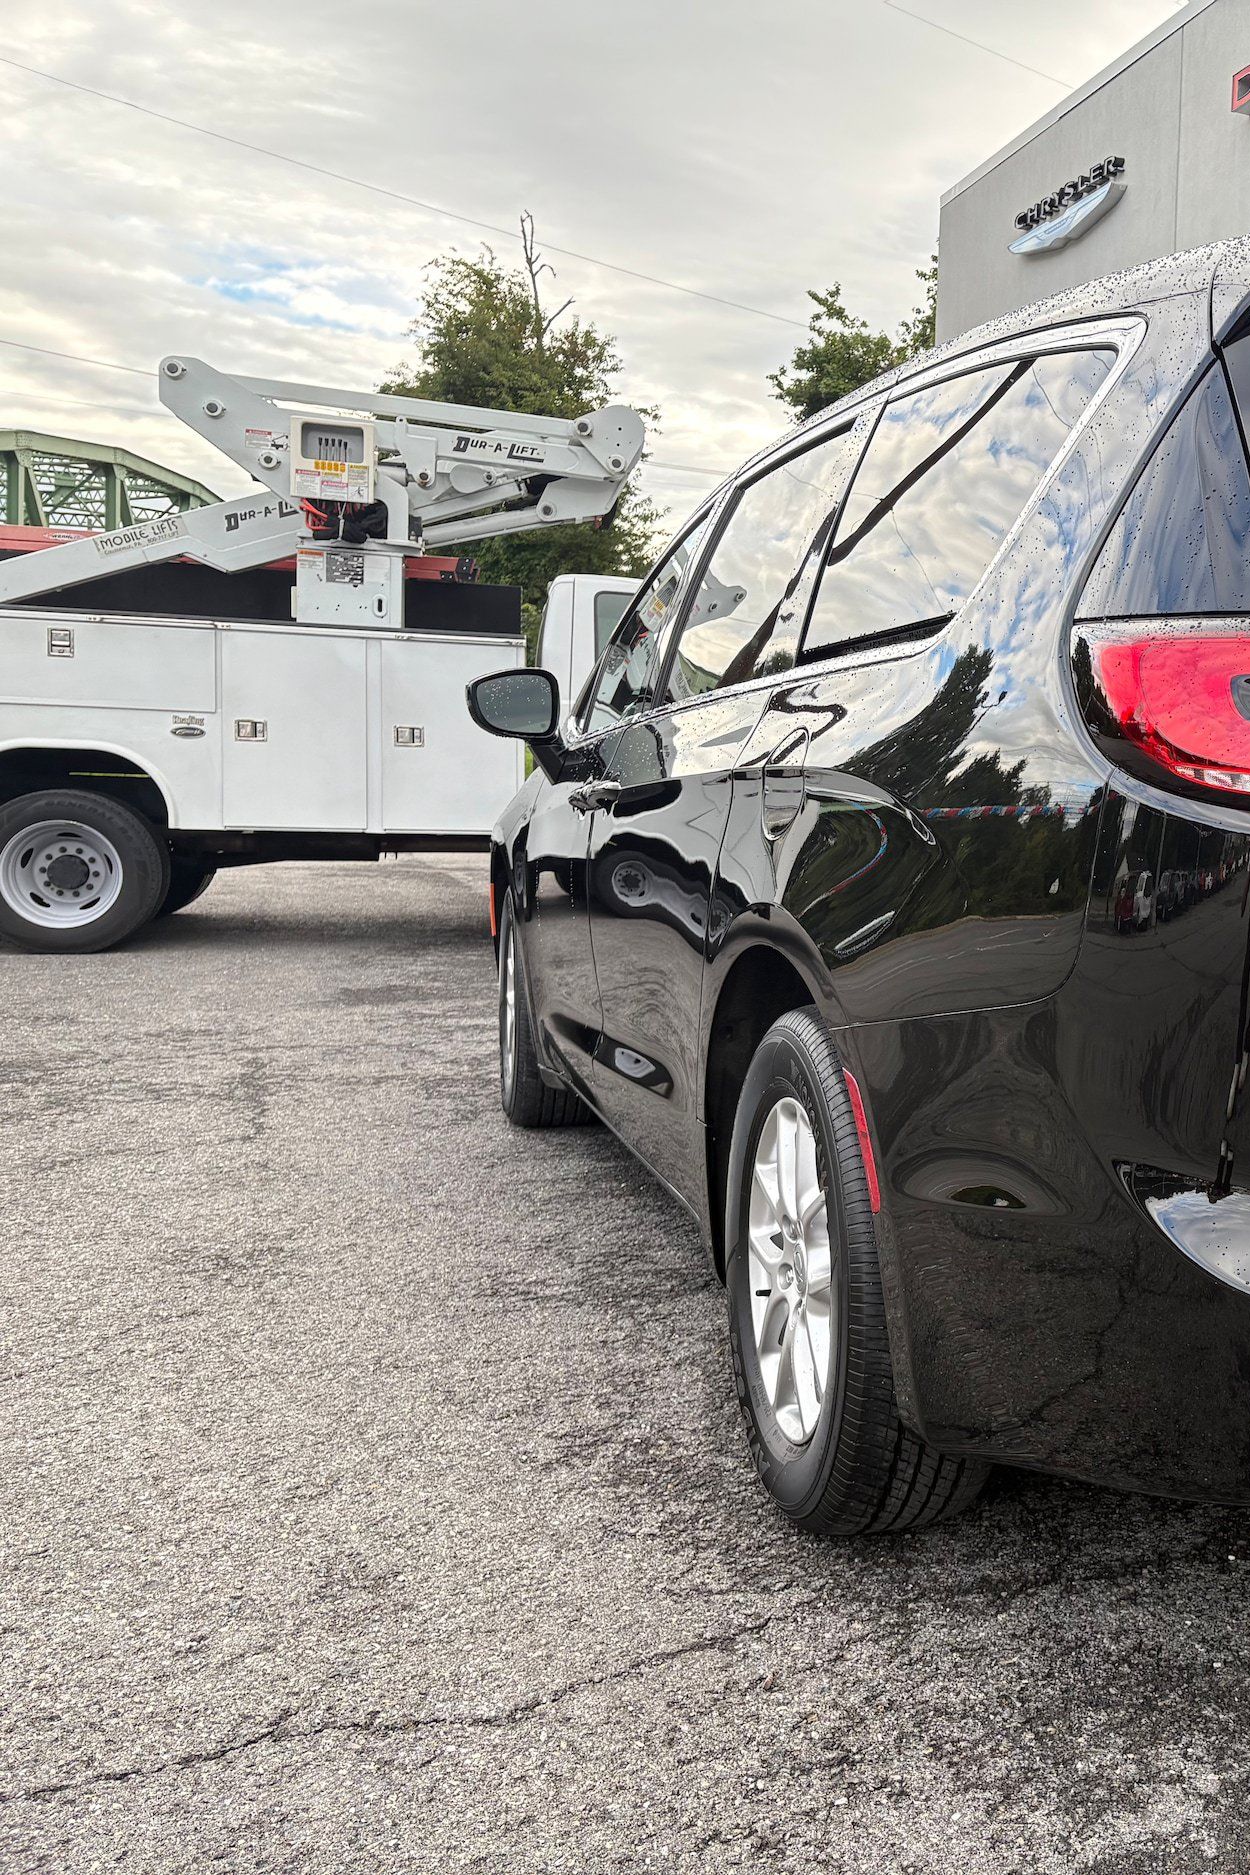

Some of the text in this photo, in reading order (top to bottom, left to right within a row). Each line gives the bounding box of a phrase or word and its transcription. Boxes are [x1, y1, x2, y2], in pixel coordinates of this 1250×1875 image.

[1014, 155, 1125, 230] CHRYSLER
[225, 501, 299, 532] DUR-A-LI
[100, 530, 149, 550] MOBILE
[151, 518, 178, 536] LIFTS
